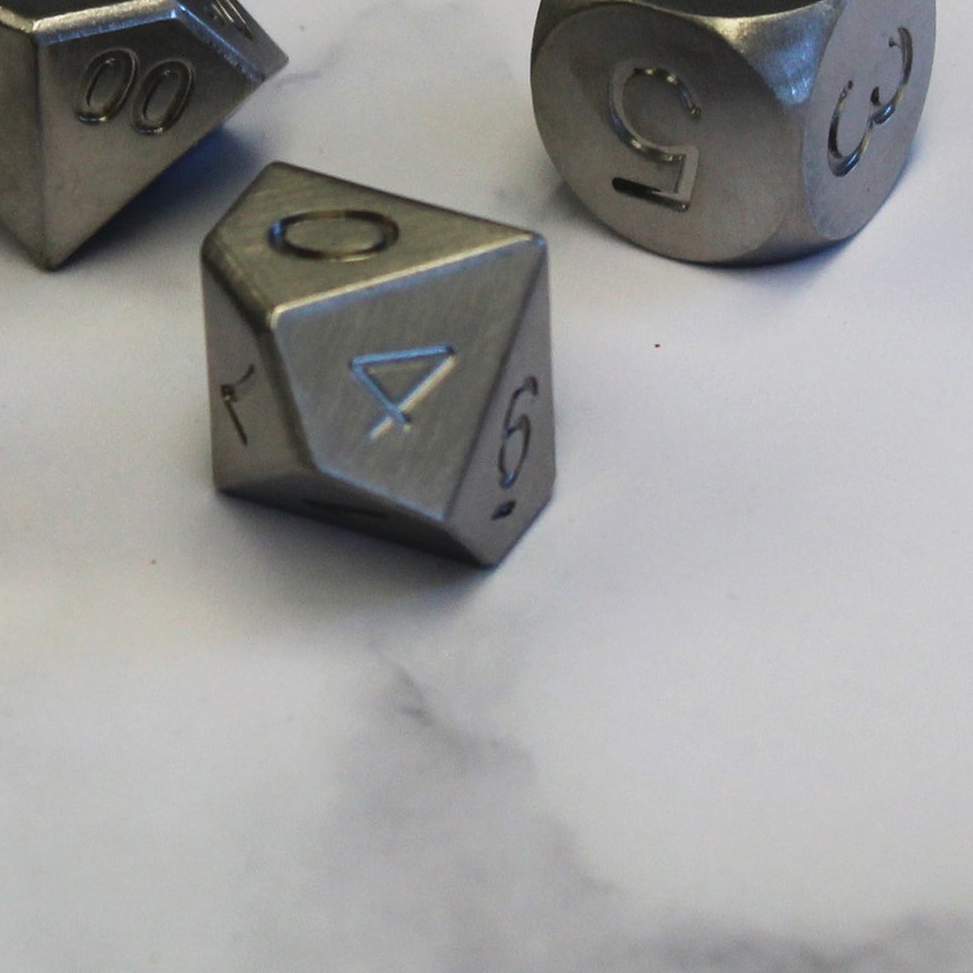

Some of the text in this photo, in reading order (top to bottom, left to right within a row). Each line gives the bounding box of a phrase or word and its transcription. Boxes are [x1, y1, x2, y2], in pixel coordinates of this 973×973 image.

[74, 47, 196, 135] 00
[607, 57, 702, 213] 5
[828, 25, 914, 178] 3
[268, 208, 400, 262] 0
[348, 344, 458, 444] 4
